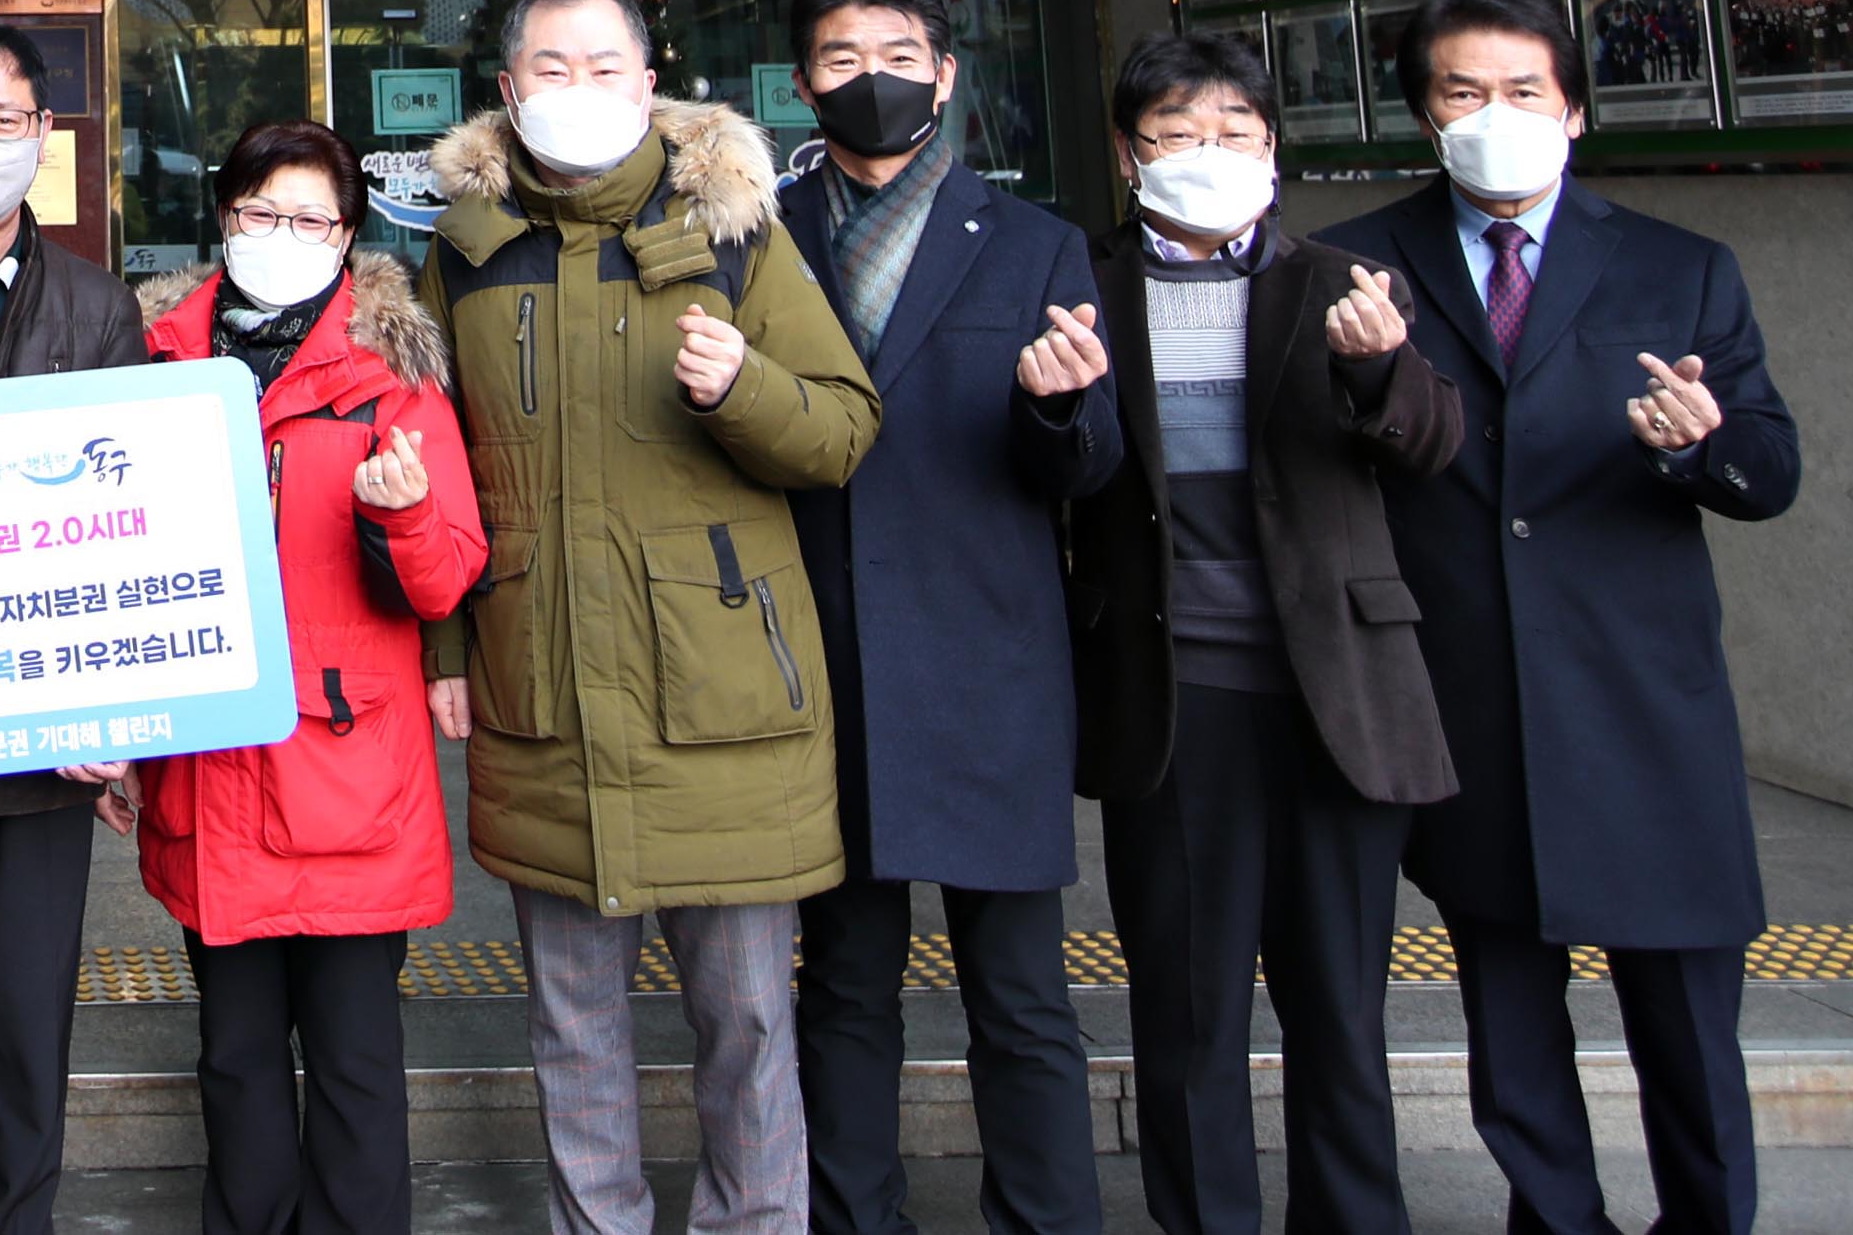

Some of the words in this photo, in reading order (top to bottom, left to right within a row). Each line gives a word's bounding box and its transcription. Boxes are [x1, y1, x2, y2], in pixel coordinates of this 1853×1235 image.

[82, 437, 132, 487] 동구
[32, 507, 148, 550] 2.0시대
[116, 568, 225, 609] 실현으로
[55, 626, 233, 676] 키우겠습니다.
[37, 720, 102, 752] 기대해
[108, 712, 173, 747] 챌린지
